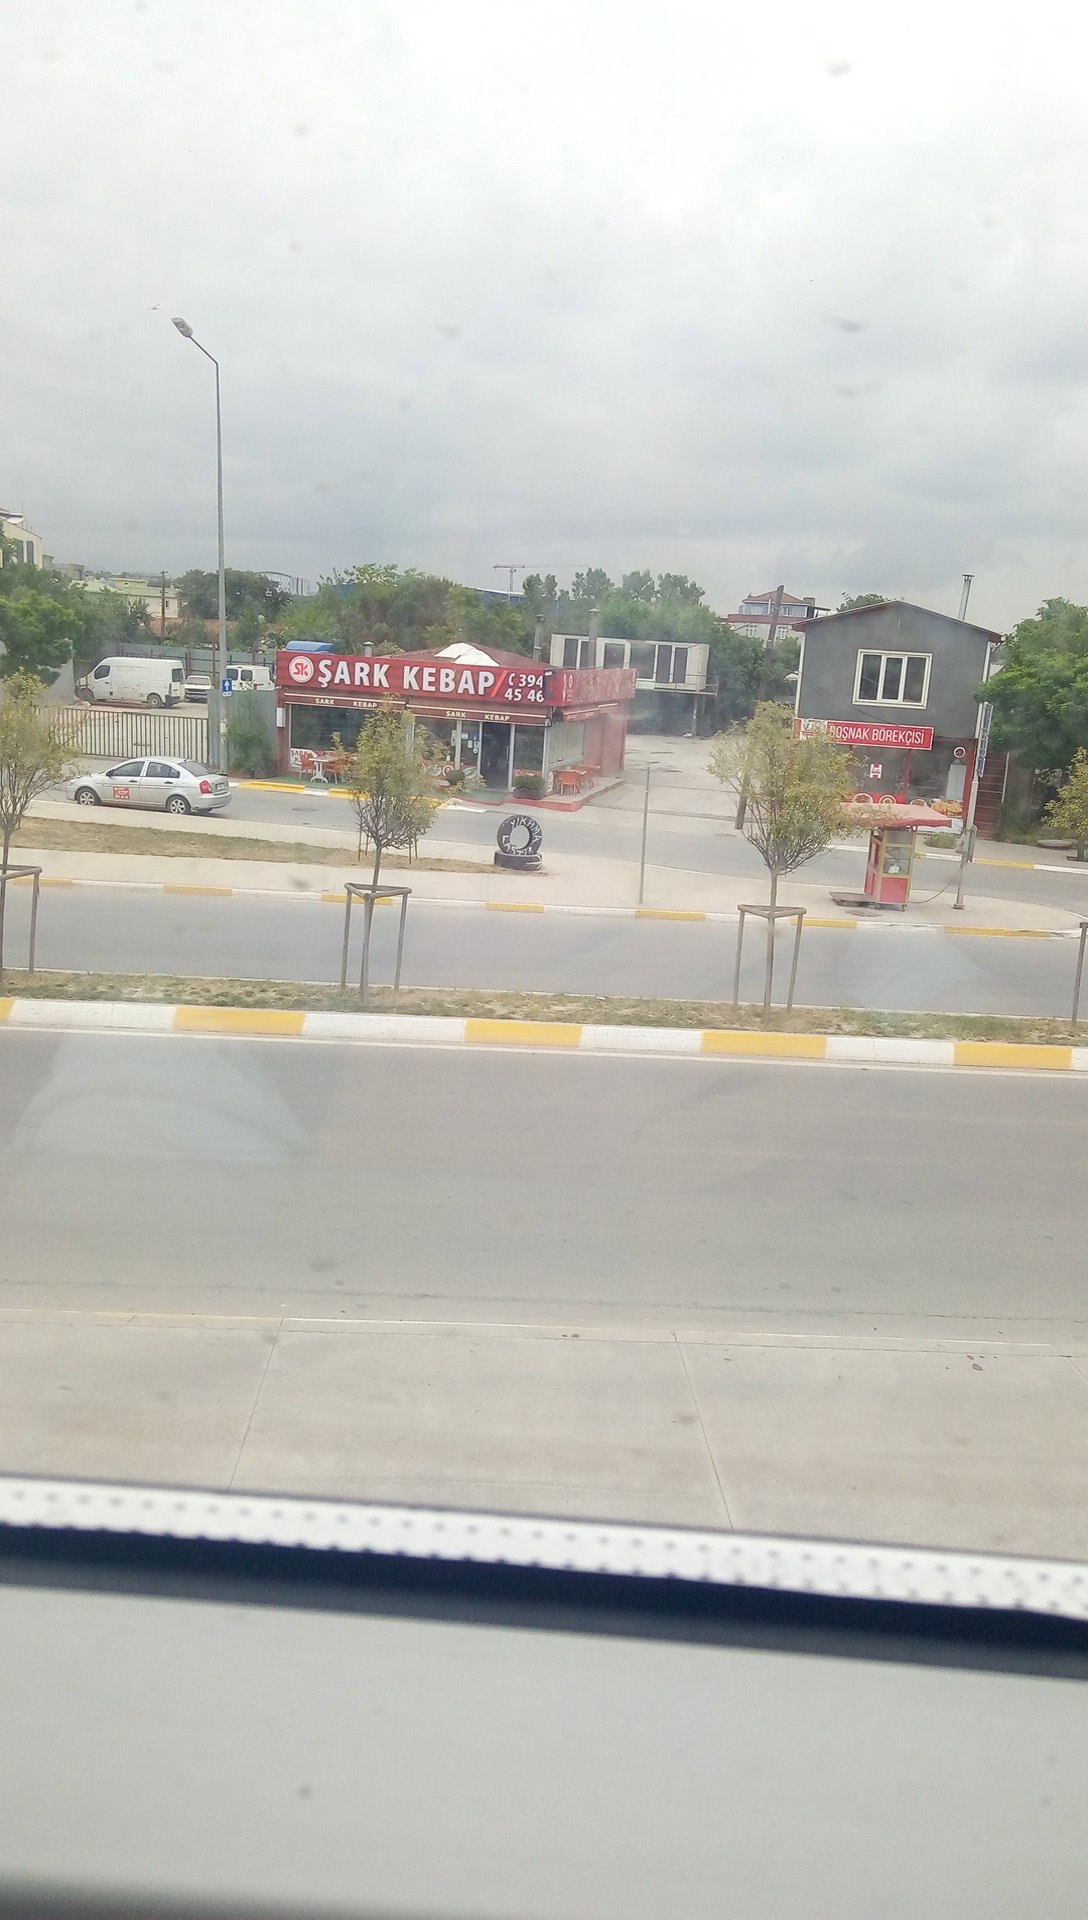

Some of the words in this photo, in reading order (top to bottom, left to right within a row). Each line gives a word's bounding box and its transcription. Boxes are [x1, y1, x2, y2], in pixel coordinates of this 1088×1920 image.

[317, 659, 390, 688] ŞARK
[403, 665, 495, 696] KEBAP
[518, 674, 544, 688] 394
[504, 688, 522, 701] 45
[527, 690, 545, 703] 46
[353, 700, 378, 709] KEBAP
[484, 713, 511, 722] KEBAP
[828, 725, 870, 741] BOŞNAK
[872, 727, 926, 746] BÖREKÇİSİ
[510, 816, 542, 843] YIKAMA
